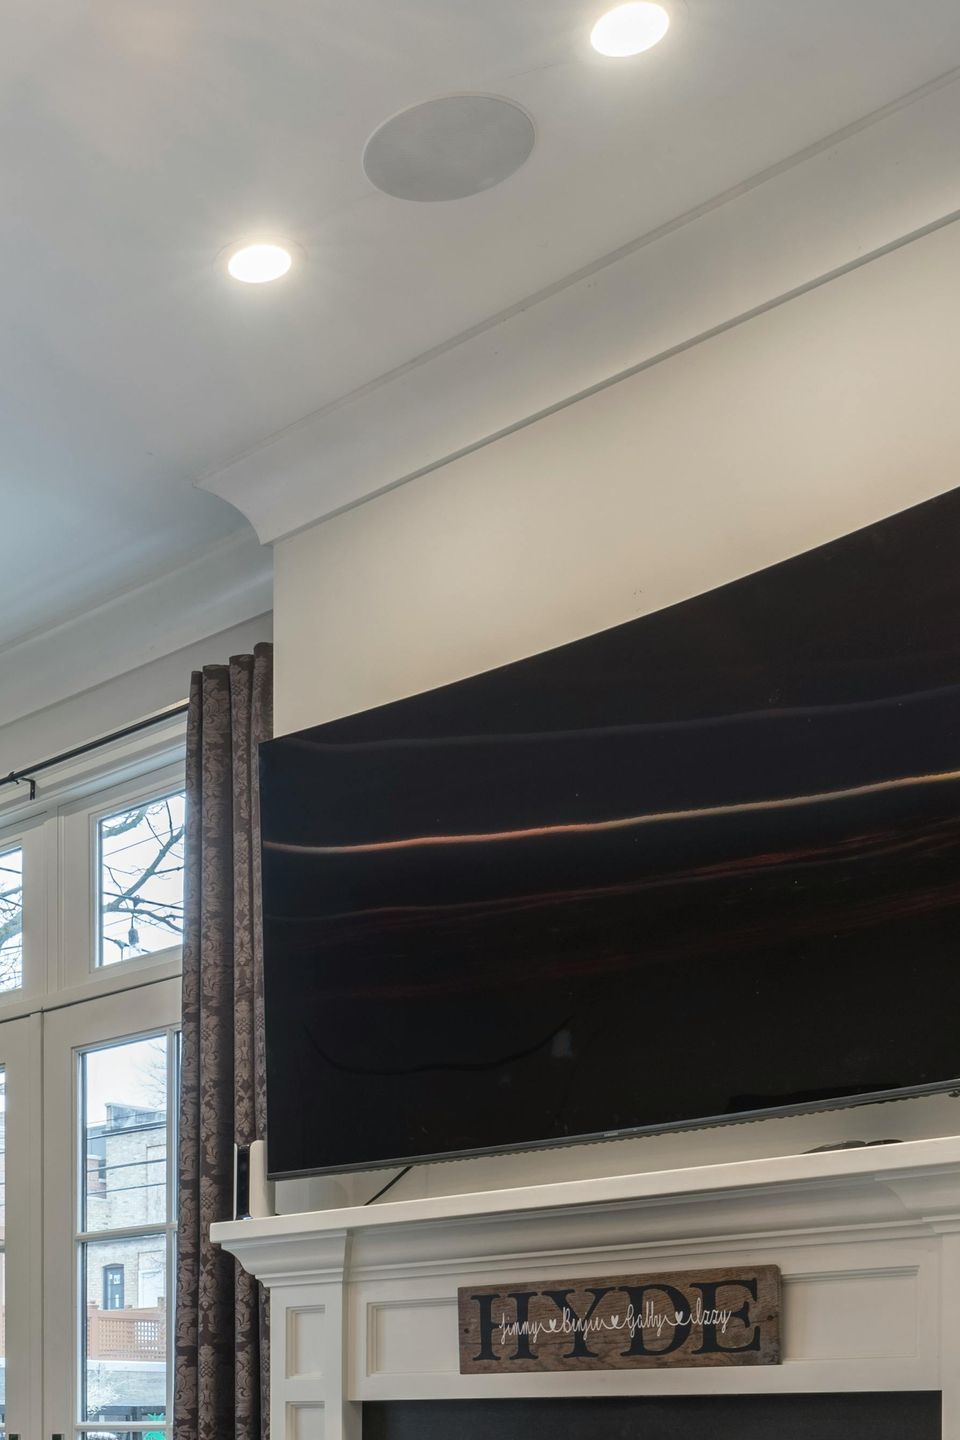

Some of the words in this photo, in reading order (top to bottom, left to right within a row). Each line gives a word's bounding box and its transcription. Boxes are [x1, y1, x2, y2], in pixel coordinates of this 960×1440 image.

[470, 1277, 761, 1361] HYDE
[498, 1312, 542, 1345] Jimmy
[625, 1300, 667, 1338] Gabby
[690, 1297, 732, 1334] Izzy
